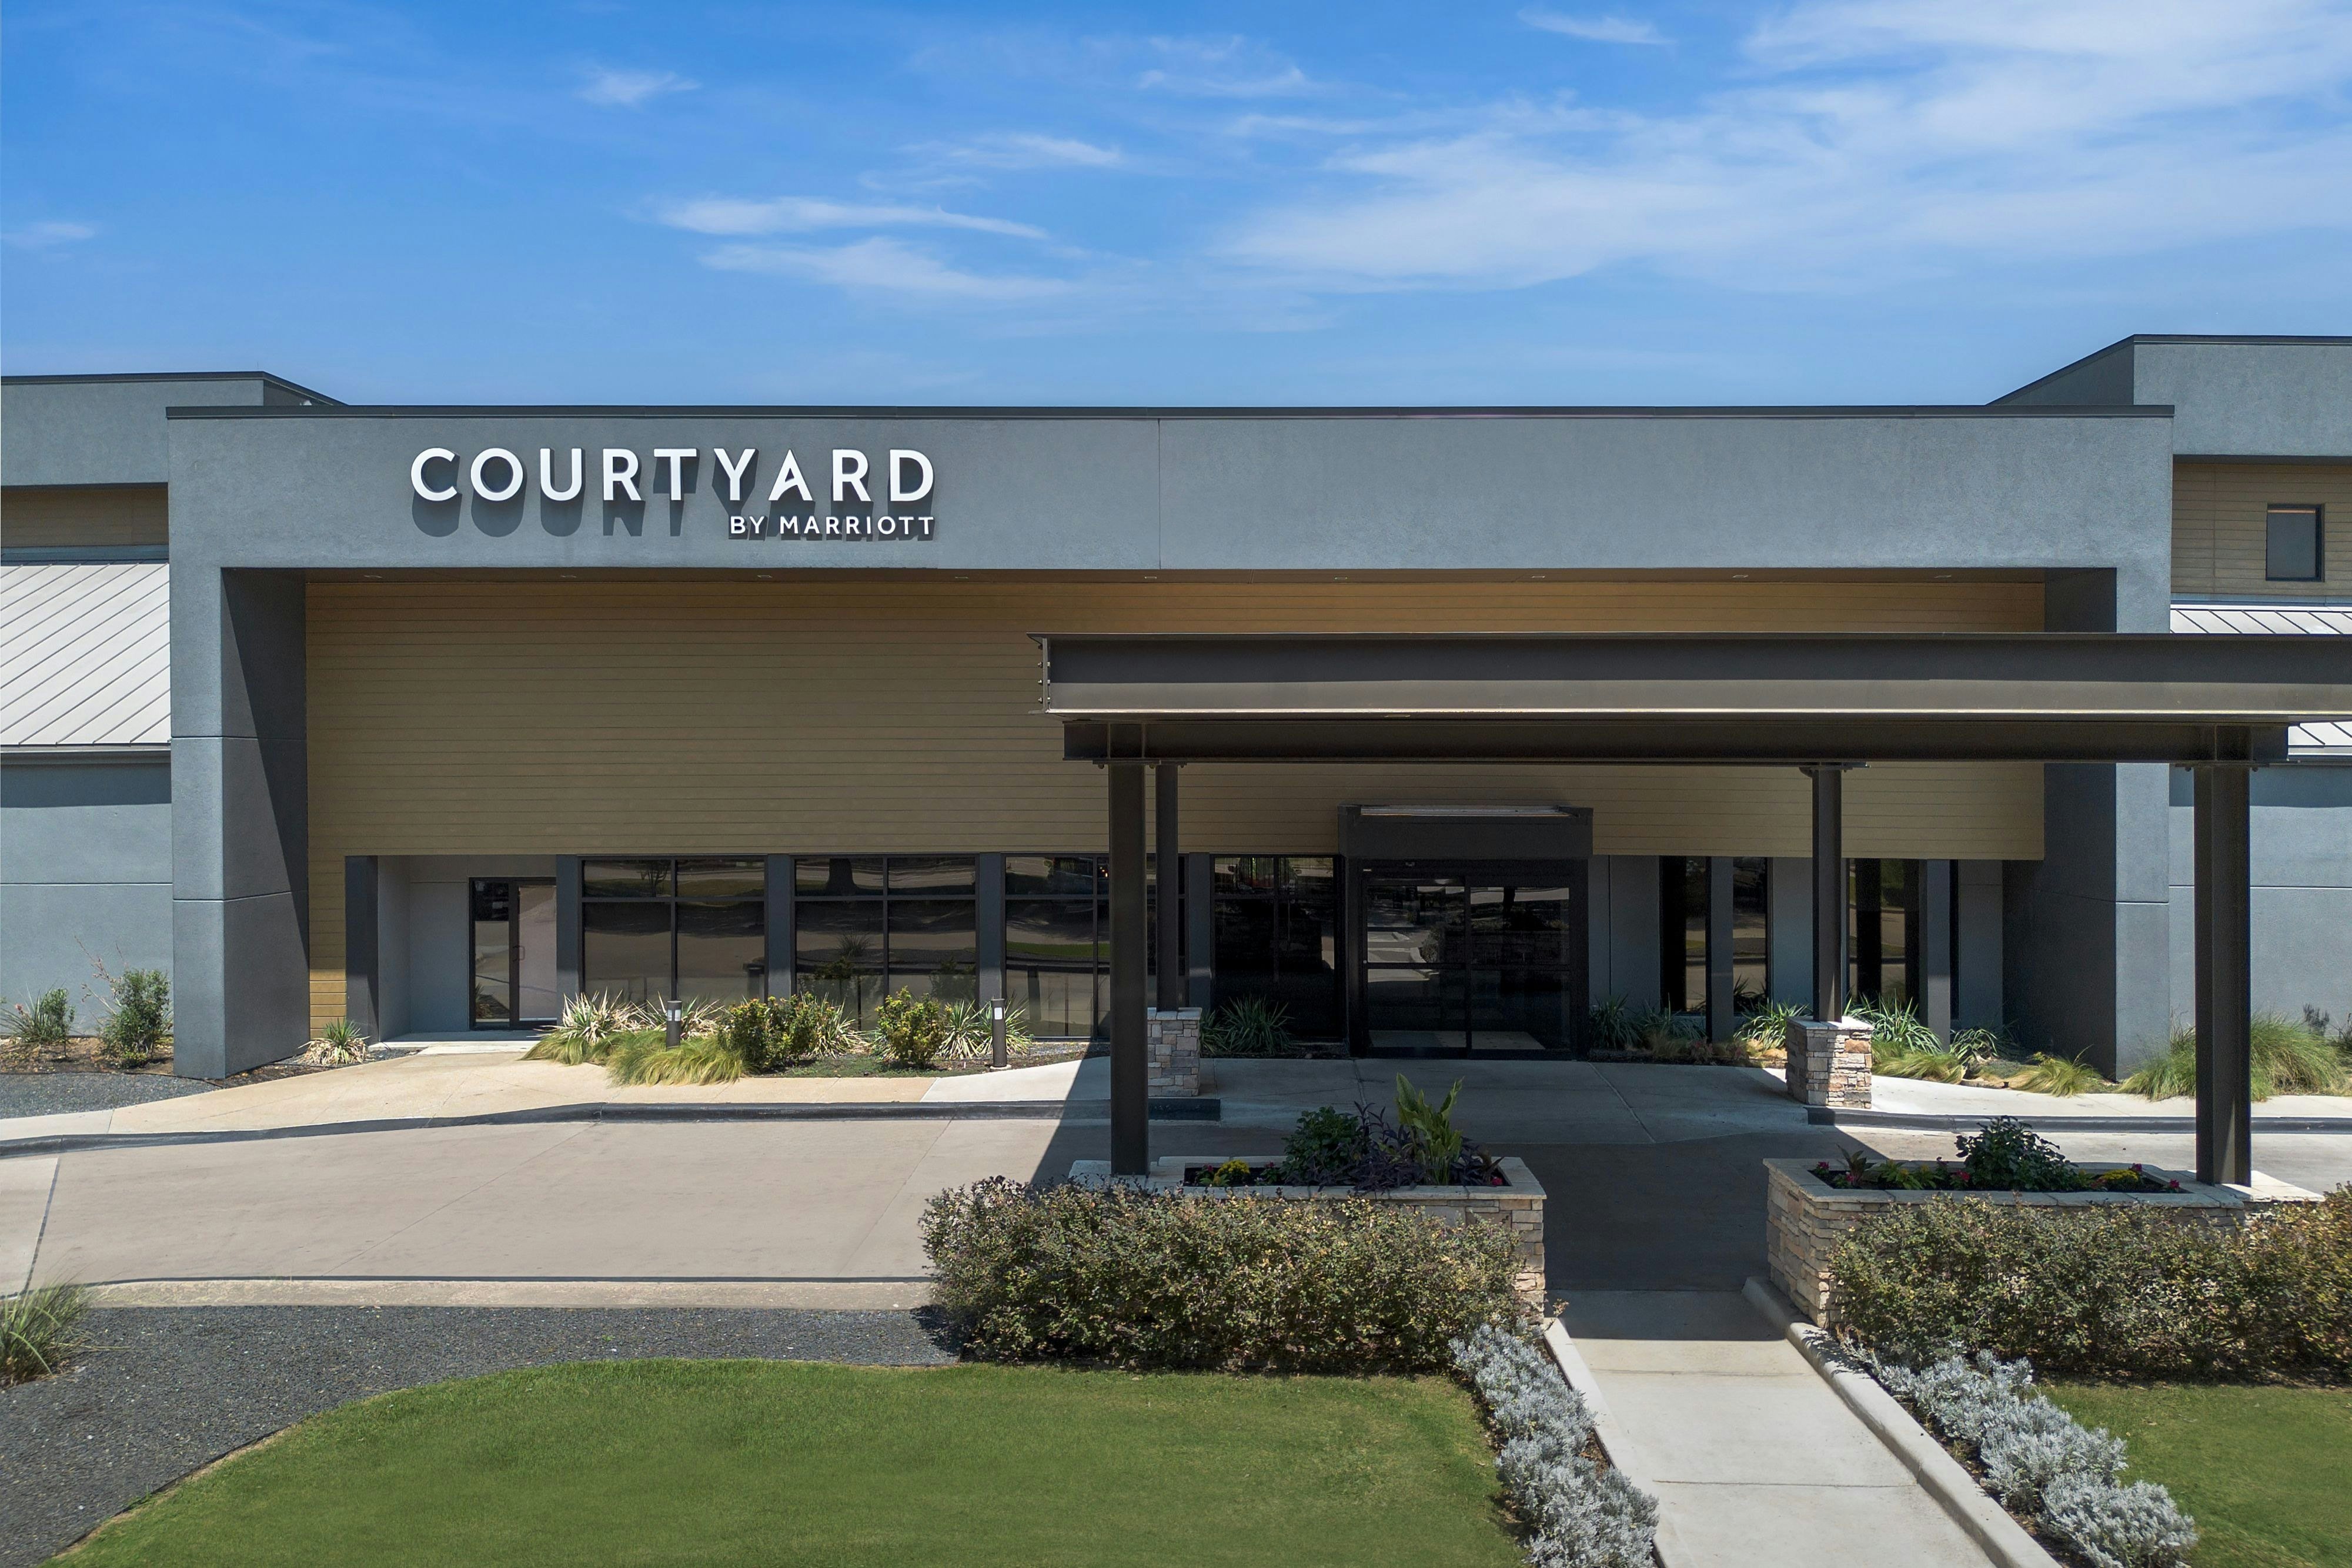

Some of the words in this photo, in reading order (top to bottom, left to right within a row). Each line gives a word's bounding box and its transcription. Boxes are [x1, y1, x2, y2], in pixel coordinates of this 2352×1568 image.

[410, 447, 934, 502] COURTYARD
[730, 516, 765, 534] BY
[780, 516, 934, 534] MARRIOTT
